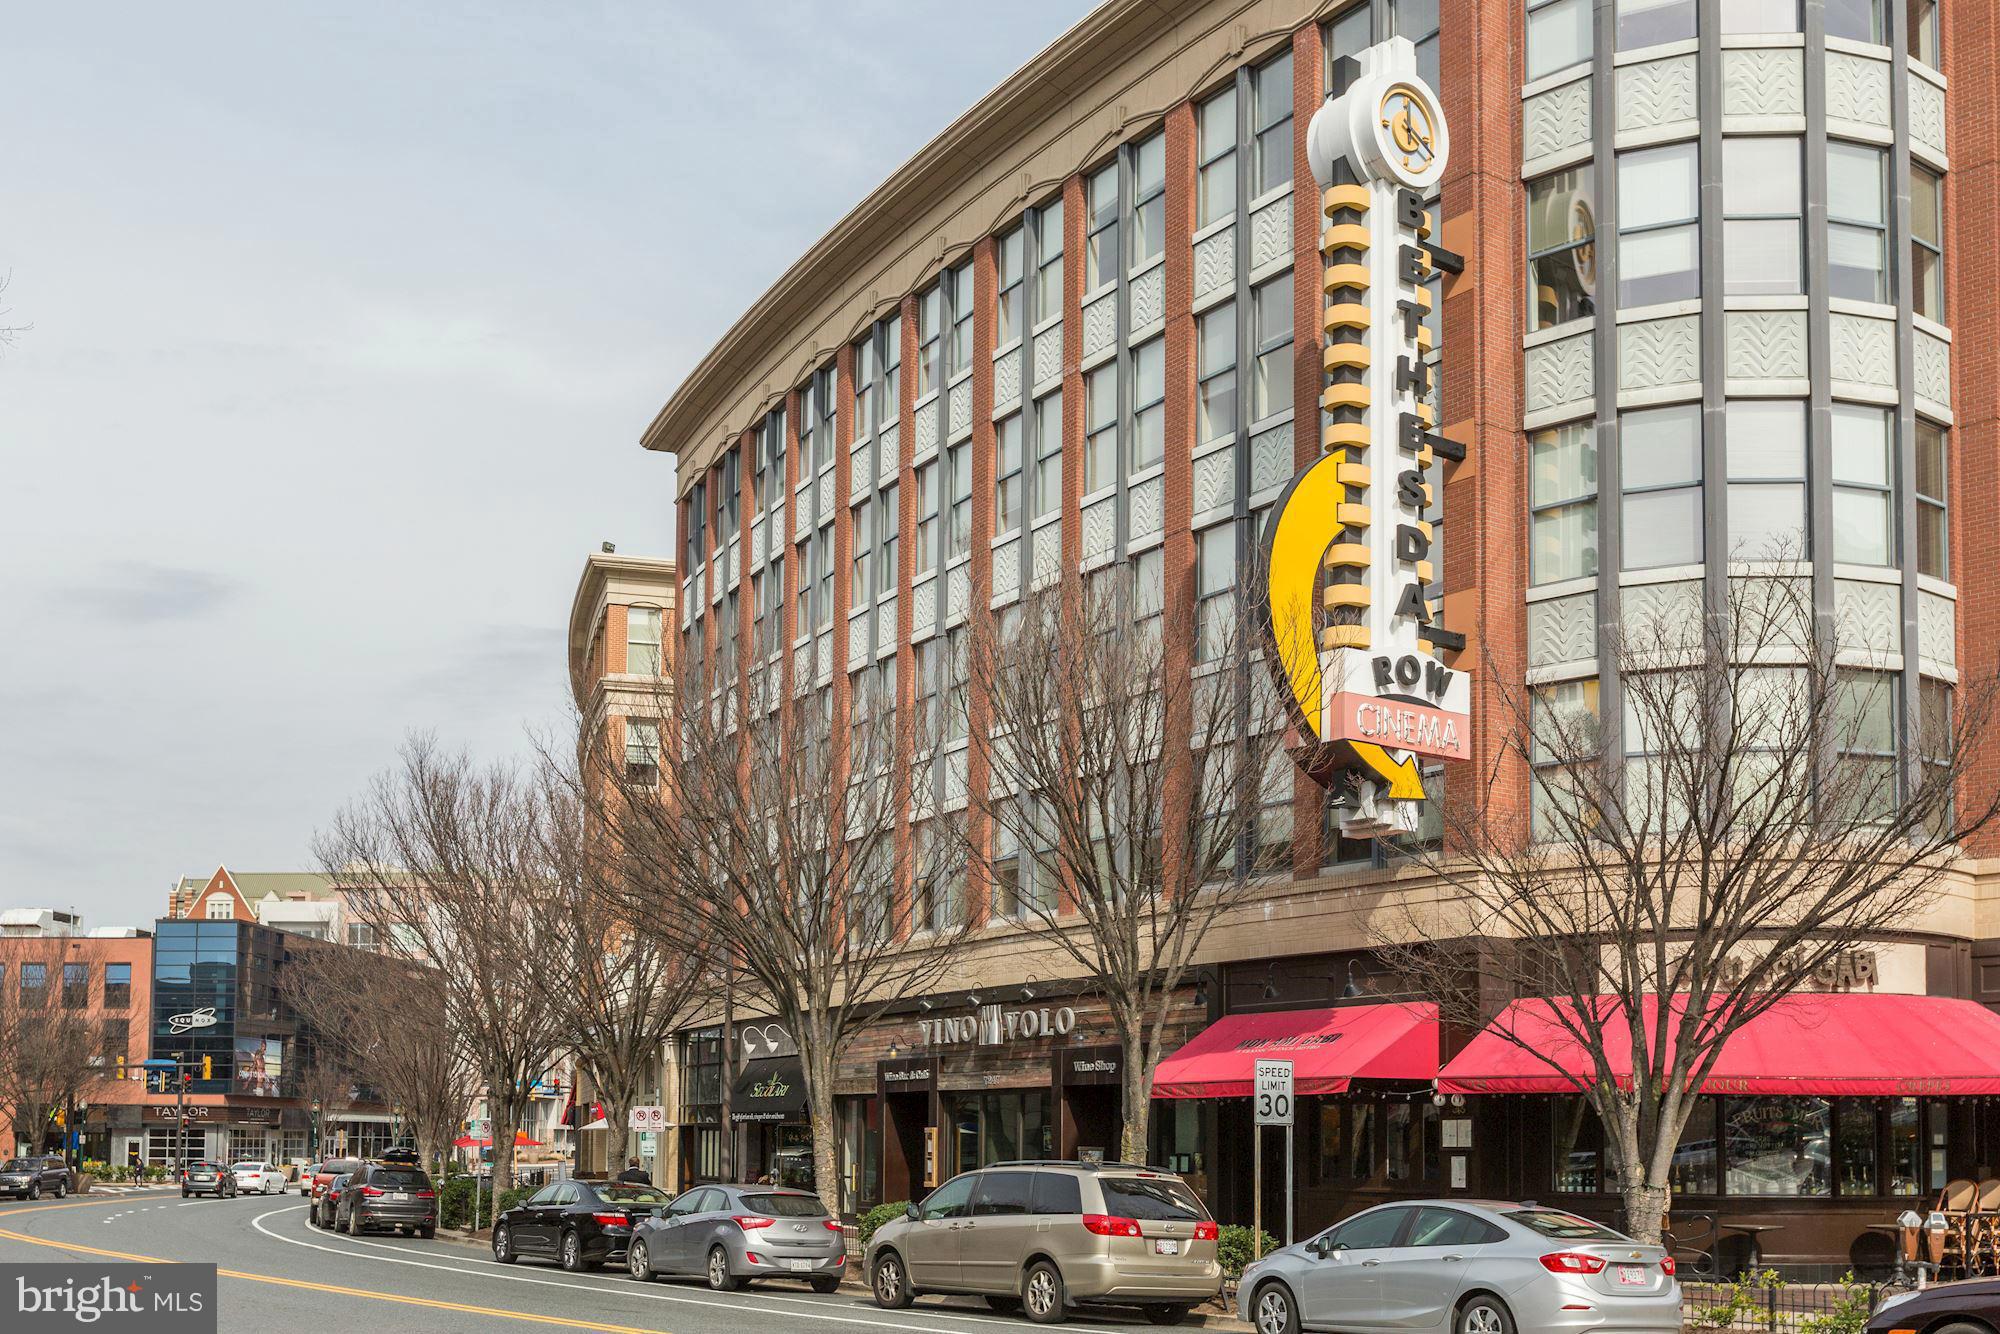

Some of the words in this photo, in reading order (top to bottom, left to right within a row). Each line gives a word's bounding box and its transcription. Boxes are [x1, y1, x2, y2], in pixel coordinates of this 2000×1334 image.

[1395, 188, 1430, 624] BETHESDA
[1372, 654, 1454, 698] ROW
[1357, 702, 1460, 751] CINEMA
[917, 1015, 978, 1046] VINO
[1003, 1006, 1075, 1041] VOLO
[1074, 1061, 1094, 1073] Wine
[1095, 1060, 1117, 1074] Shop
[1258, 1067, 1290, 1079] SPEED
[1261, 1080, 1286, 1092] LIMIT
[1705, 1078, 1749, 1092] JOUR
[153, 1106, 208, 1117] TAYOR
[1258, 1093, 1290, 1118] 30
[1731, 1105, 1784, 1125] FRUITS
